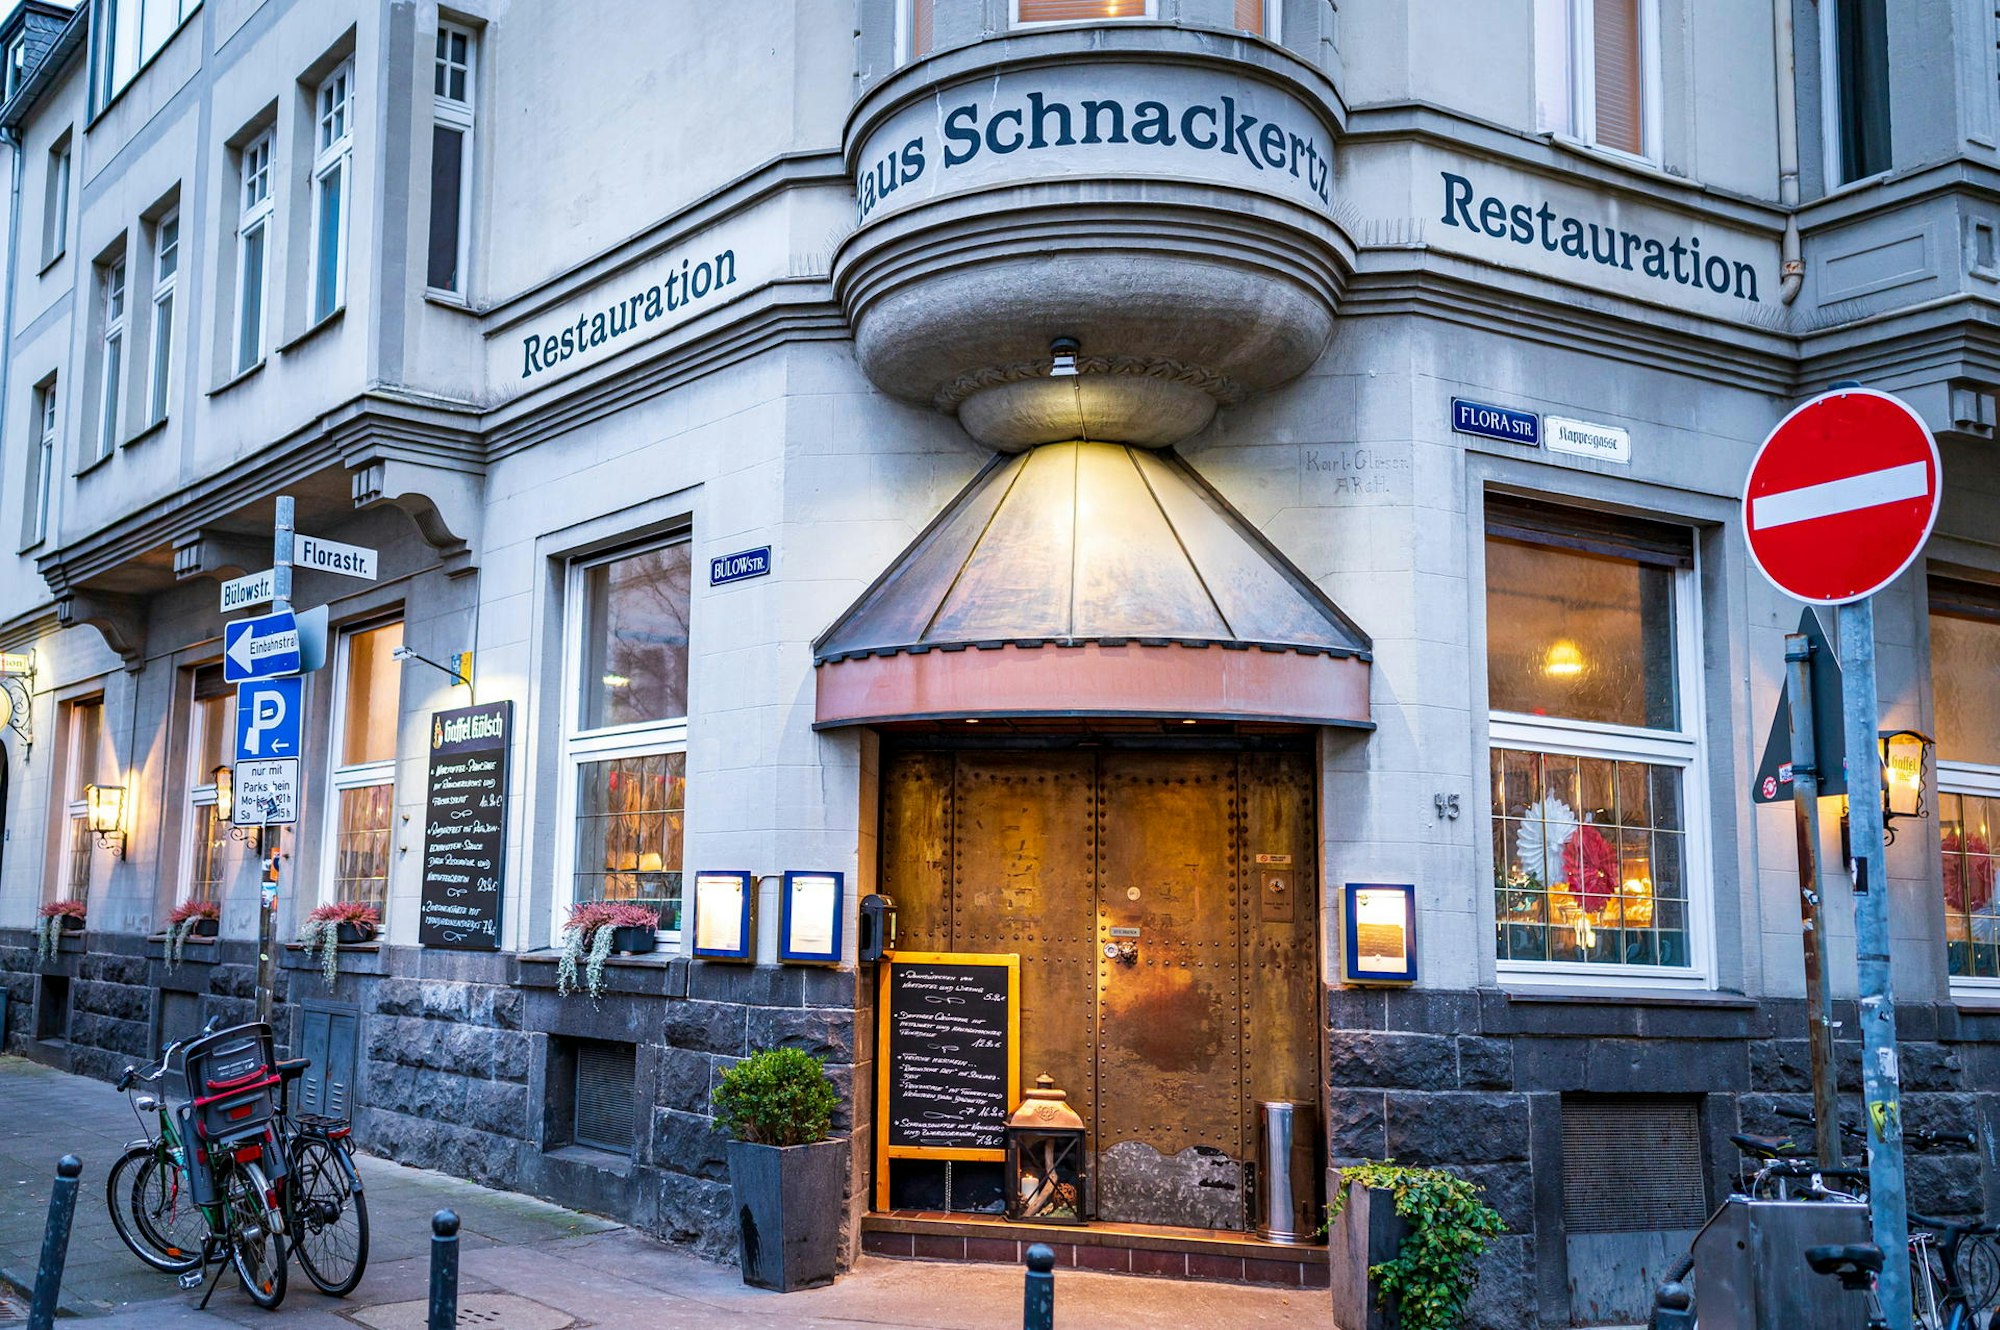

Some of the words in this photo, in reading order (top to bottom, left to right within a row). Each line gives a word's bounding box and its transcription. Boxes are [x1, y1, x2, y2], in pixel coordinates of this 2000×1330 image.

[944, 91, 1329, 205] Schnackertz
[1440, 171, 1760, 302] Restauration
[521, 249, 737, 379] Restauration
[1461, 406, 1511, 432] FLORA
[303, 541, 368, 574] Florastr.
[224, 577, 271, 607] Bülowstr.
[253, 690, 286, 755] P
[444, 716, 472, 744] Gaffel
[251, 768, 266, 777] nur
[269, 764, 282, 775] mit
[243, 780, 290, 793] Parkshein
[1434, 793, 1460, 820] 45
